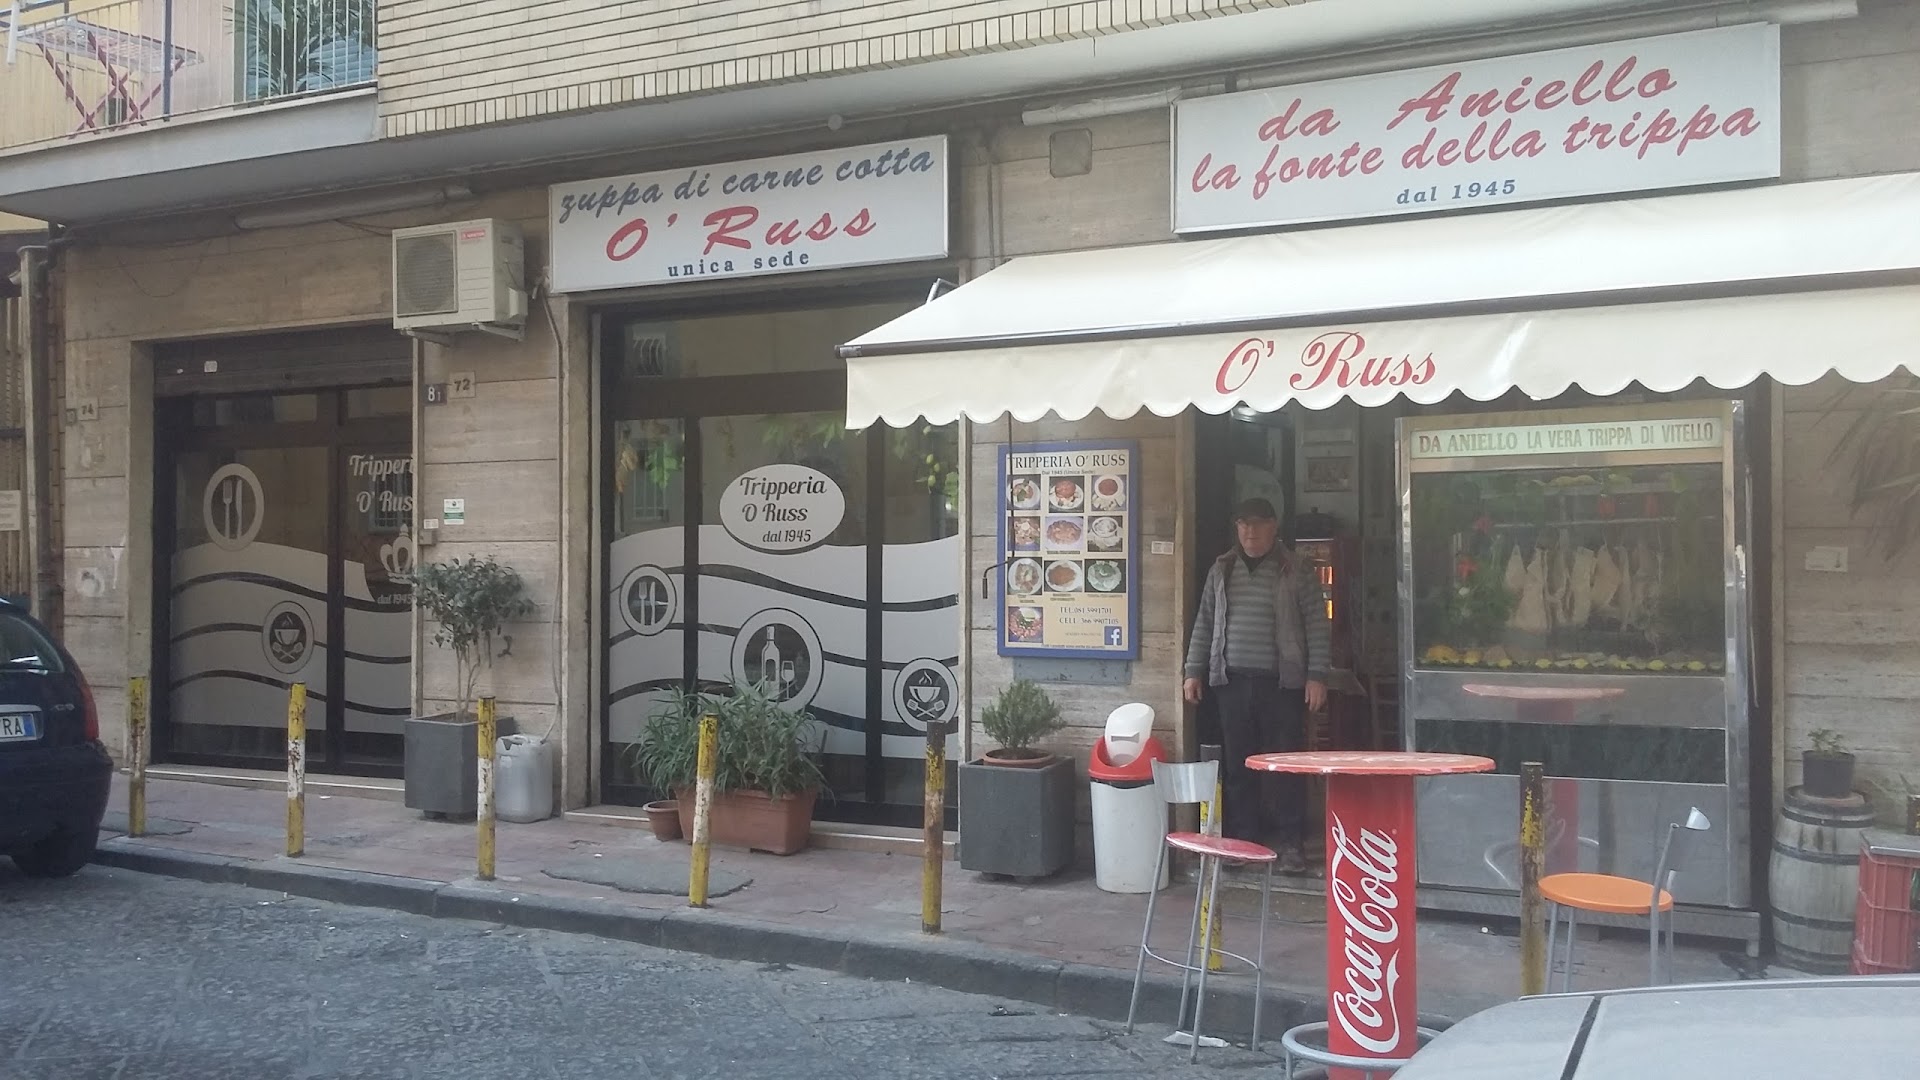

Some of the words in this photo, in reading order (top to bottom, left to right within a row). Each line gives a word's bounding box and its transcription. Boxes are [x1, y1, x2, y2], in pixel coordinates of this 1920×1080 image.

[1257, 99, 1341, 143] da
[1386, 55, 1677, 132] Aniello
[1192, 153, 1241, 193] la
[1252, 141, 1384, 200] fonte
[1402, 121, 1546, 169] della
[1563, 104, 1761, 160] trippa
[559, 182, 664, 224] zuppa
[674, 170, 710, 201] di
[722, 164, 823, 195] carne
[836, 146, 934, 182] cotta
[1396, 185, 1438, 205] dal
[1452, 179, 1516, 200] 1945
[703, 205, 877, 256] Russ
[667, 258, 735, 278] unica
[754, 251, 810, 270] sede
[1215, 337, 1275, 395] O'
[1289, 331, 1437, 391] Russ
[454, 378, 471, 392] 72
[1419, 435, 1442, 454] DA
[1447, 432, 1518, 453] ANIELLO
[1527, 431, 1542, 449] LA
[1548, 428, 1582, 448] VERA
[1588, 426, 1633, 446] TRIPPA
[1641, 425, 1654, 445] DI
[1661, 422, 1714, 443] VITELLO
[1092, 454, 1126, 467] RUSS
[739, 475, 827, 501] Tripperia
[762, 502, 808, 523] Russ
[762, 529, 782, 543] dal
[784, 529, 811, 543] 1945
[0, 717, 23, 735] RA
[1331, 810, 1400, 1053] Coca-Cola
